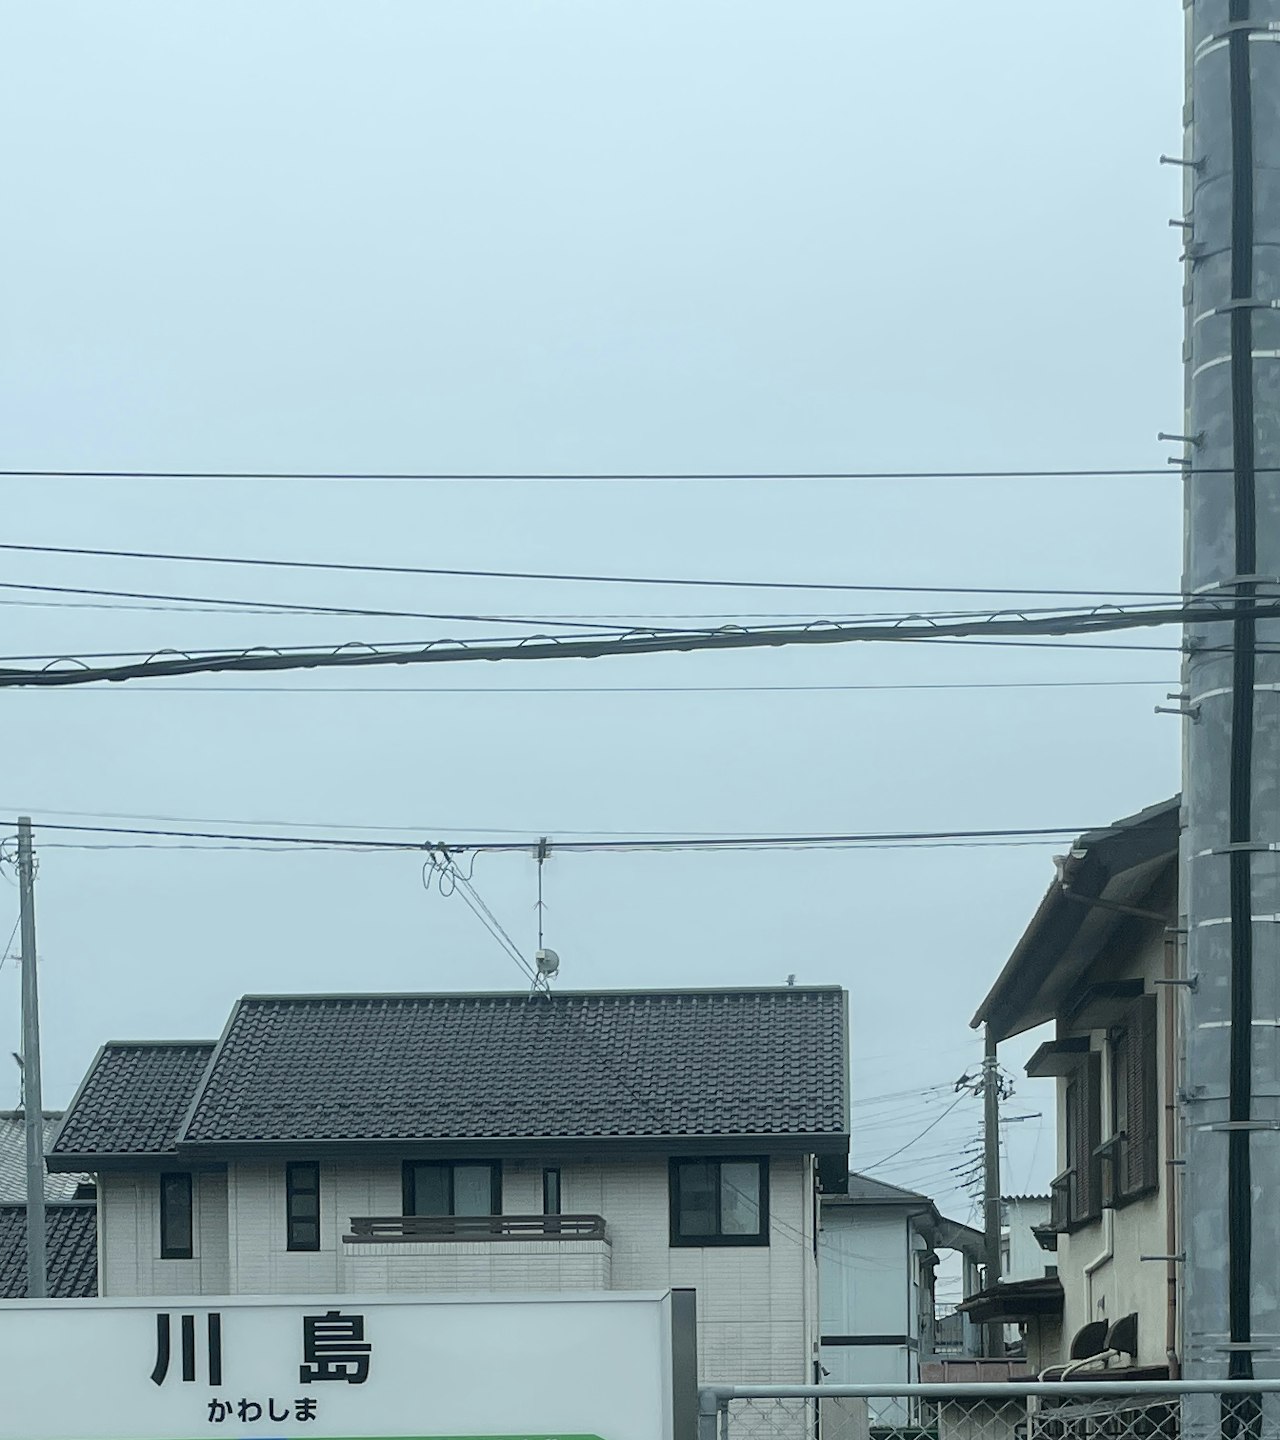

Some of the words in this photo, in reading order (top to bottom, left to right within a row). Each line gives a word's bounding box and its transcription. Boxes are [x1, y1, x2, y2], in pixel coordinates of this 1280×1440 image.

[150, 1311, 372, 1386] 川島
[207, 1397, 317, 1423] かわしま
